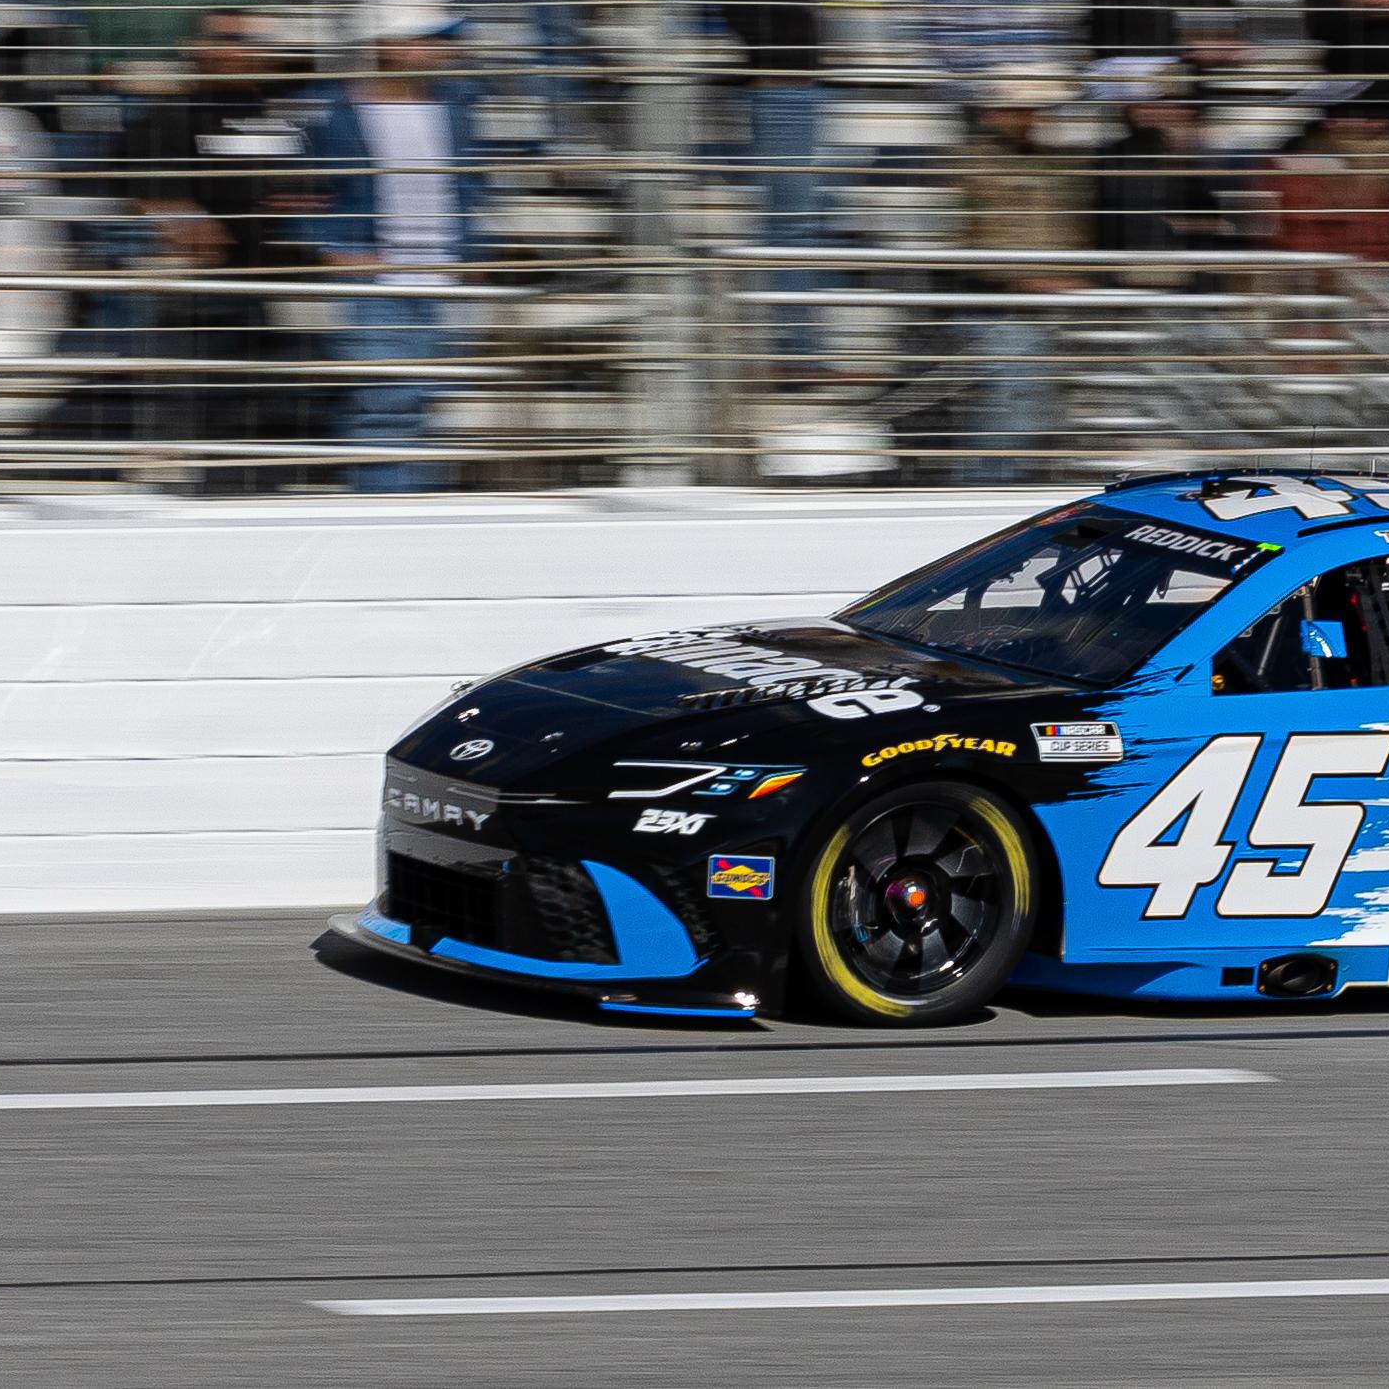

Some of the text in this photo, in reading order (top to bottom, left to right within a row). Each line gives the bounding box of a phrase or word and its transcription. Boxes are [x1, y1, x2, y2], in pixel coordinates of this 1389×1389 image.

[1123, 524, 1247, 561] REDDICK
[861, 733, 1017, 767] GOODYEAR
[1050, 740, 1111, 752] CUP SERIES
[384, 787, 490, 831] CAMRY
